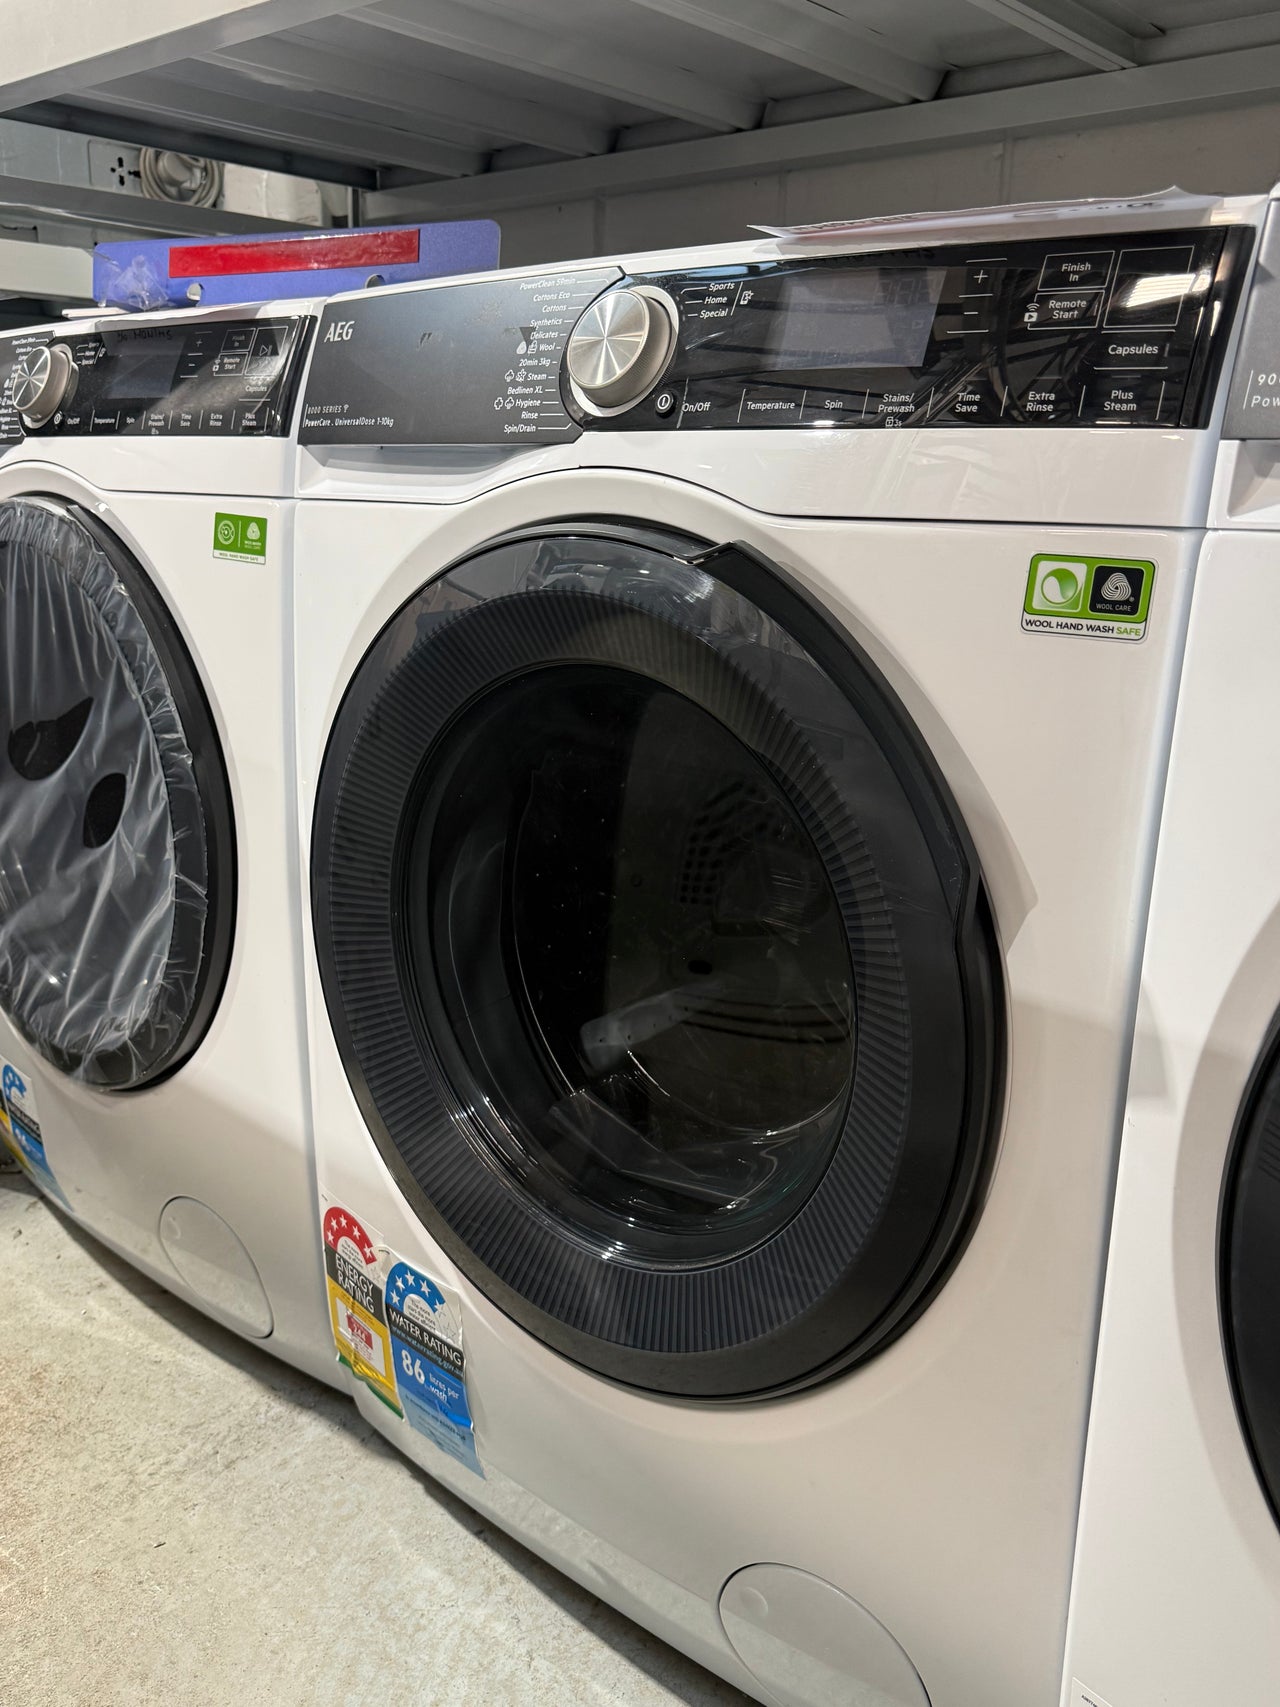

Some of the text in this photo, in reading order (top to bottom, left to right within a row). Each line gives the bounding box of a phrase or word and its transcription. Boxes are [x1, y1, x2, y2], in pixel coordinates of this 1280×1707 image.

[1061, 262, 1091, 272] Finish
[1068, 273, 1079, 282] In
[520, 280, 554, 290] PowerClean
[709, 281, 735, 293] Sports
[533, 291, 570, 302] Cottons Eco
[704, 295, 727, 305] Home
[542, 305, 567, 313] Cottons
[1049, 299, 1087, 309] Remote
[700, 309, 728, 319] Special
[1052, 309, 1078, 319] Start
[530, 318, 562, 330] Synthetics
[324, 320, 355, 343] AEG
[530, 331, 558, 340] Delicates
[539, 343, 556, 351] Wool
[1108, 344, 1158, 357] Capsules
[519, 358, 551, 367] 20min 3kg
[527, 373, 547, 381] Steam
[507, 386, 543, 395] Bedlinen XL
[1111, 390, 1134, 400] Plus
[883, 392, 915, 403] Stains/
[957, 392, 981, 402] Time
[1028, 391, 1055, 401] Extra
[515, 398, 541, 409] Hygiene
[682, 402, 711, 412] On/Off
[747, 401, 795, 412] Temperature
[824, 400, 843, 411] Spin
[878, 403, 915, 413] Prewash
[955, 402, 978, 413] Save
[1026, 402, 1053, 412] Rinse
[1104, 401, 1137, 412] Steam
[322, 405, 342, 414] SERIES
[521, 411, 538, 419] Rinse
[305, 419, 331, 427] PowerCare
[335, 417, 375, 426] UniversalDose
[504, 424, 536, 434] Spin/Drain
[1096, 602, 1131, 612] WOOL CARE
[1025, 619, 1141, 636] WOOL HAND WASH SAFE
[336, 1253, 374, 1297] ENERGY
[338, 1270, 374, 1313] RATING
[389, 1308, 422, 1340] WATER
[423, 1332, 461, 1365] RATING
[402, 1349, 425, 1384] 86
[447, 1387, 459, 1399] per
[429, 1385, 448, 1402] wash
